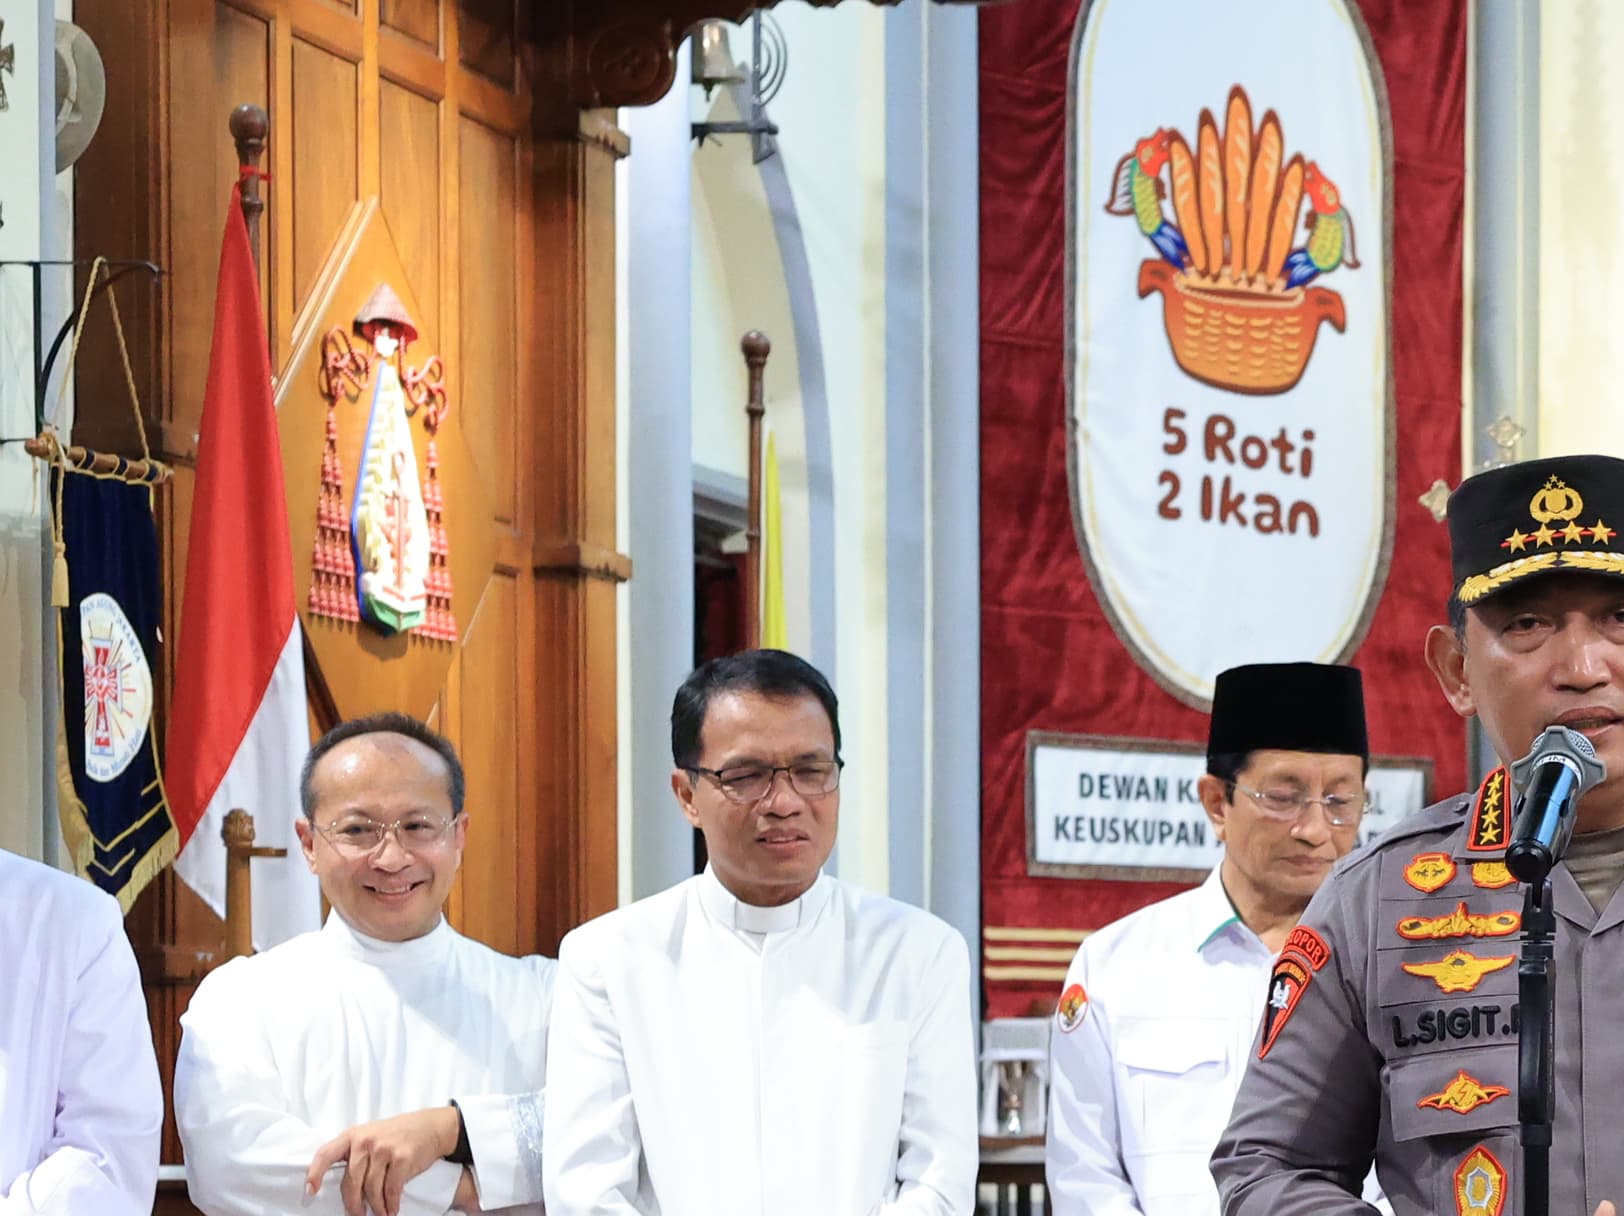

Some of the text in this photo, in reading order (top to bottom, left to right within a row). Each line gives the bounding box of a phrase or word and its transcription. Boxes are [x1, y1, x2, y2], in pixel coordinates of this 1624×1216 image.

[1163, 406, 1315, 479] 5 Roti
[1158, 469, 1319, 538] 2 Ikan
[1079, 773, 1168, 802] DEWAN
[1054, 814, 1205, 847] KEUSKUPAN
